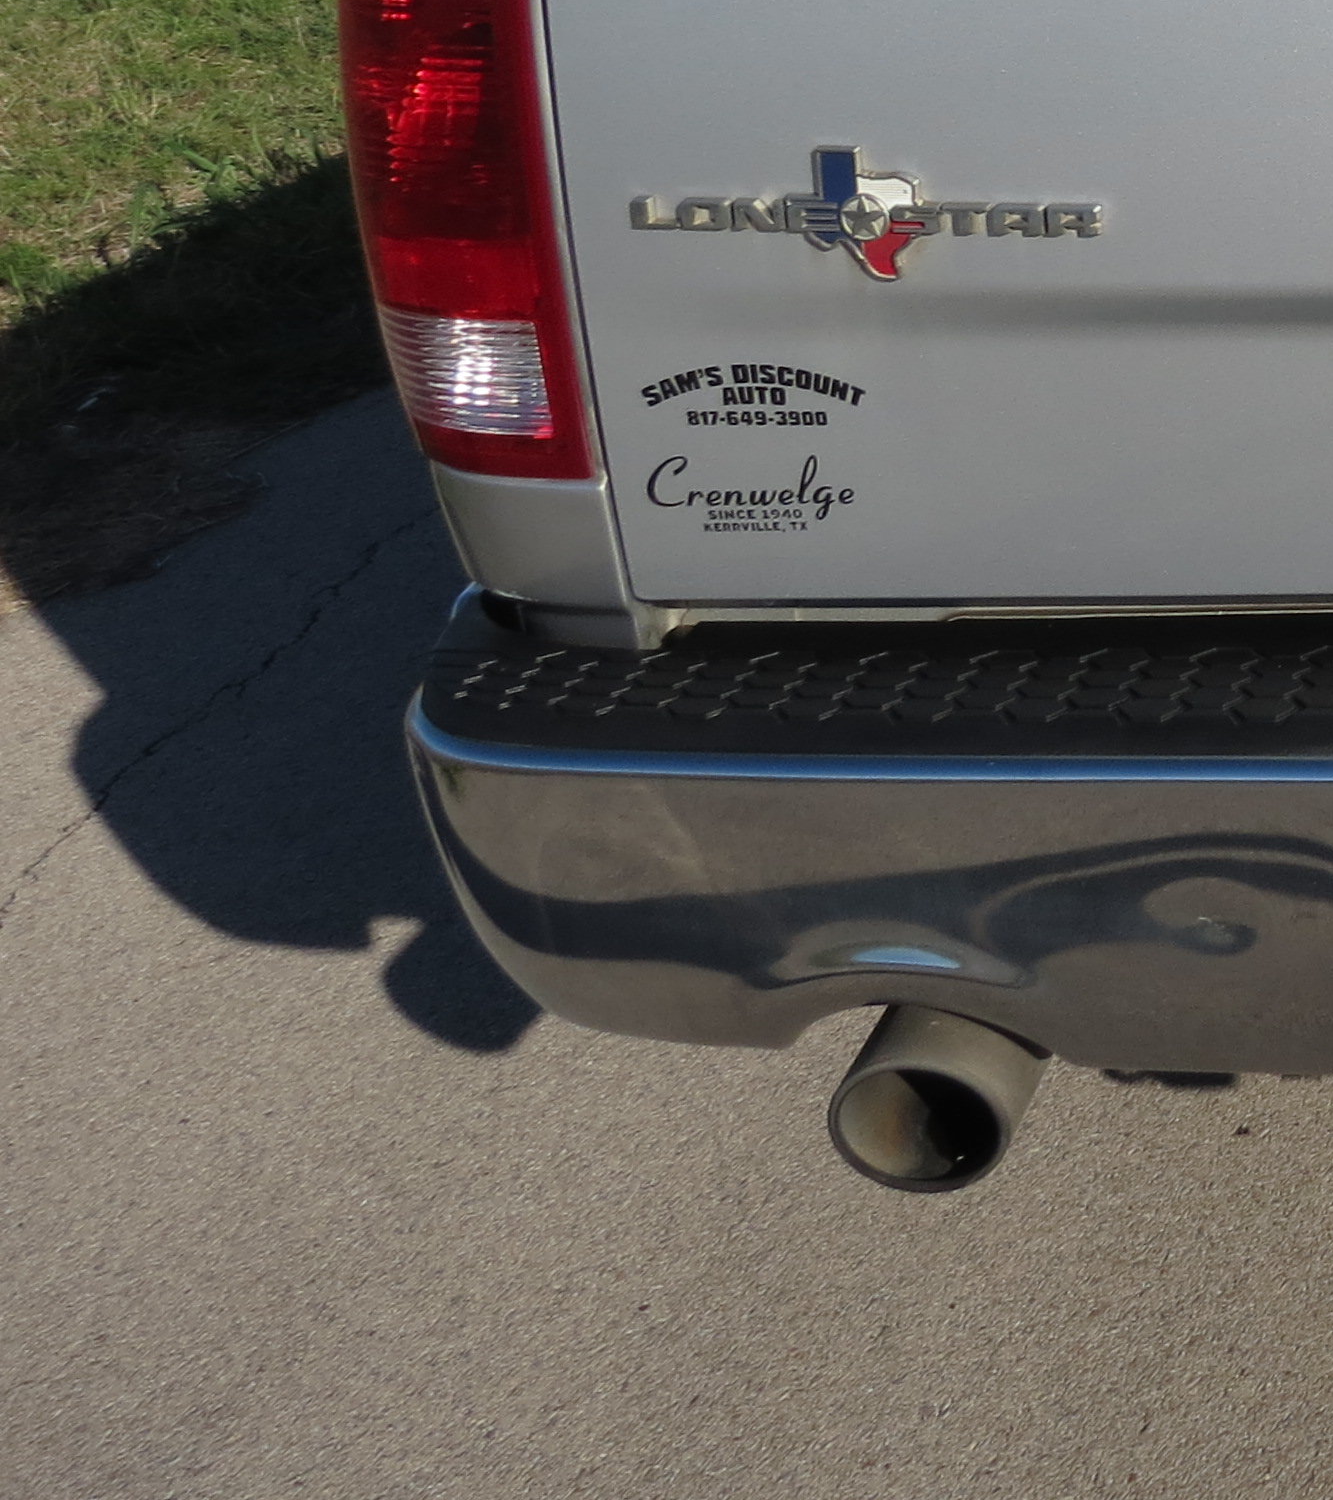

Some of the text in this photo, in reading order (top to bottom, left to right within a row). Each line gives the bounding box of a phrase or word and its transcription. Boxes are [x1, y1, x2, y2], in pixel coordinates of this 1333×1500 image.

[629, 195, 1102, 238] LONE STAR
[641, 364, 866, 407] SAM'S DISCOUNT
[722, 386, 787, 406] AUTO
[687, 411, 828, 426] 817-649-3900
[646, 454, 855, 520] Crenwelge
[708, 509, 756, 520] SINCE
[790, 522, 808, 531] TX
